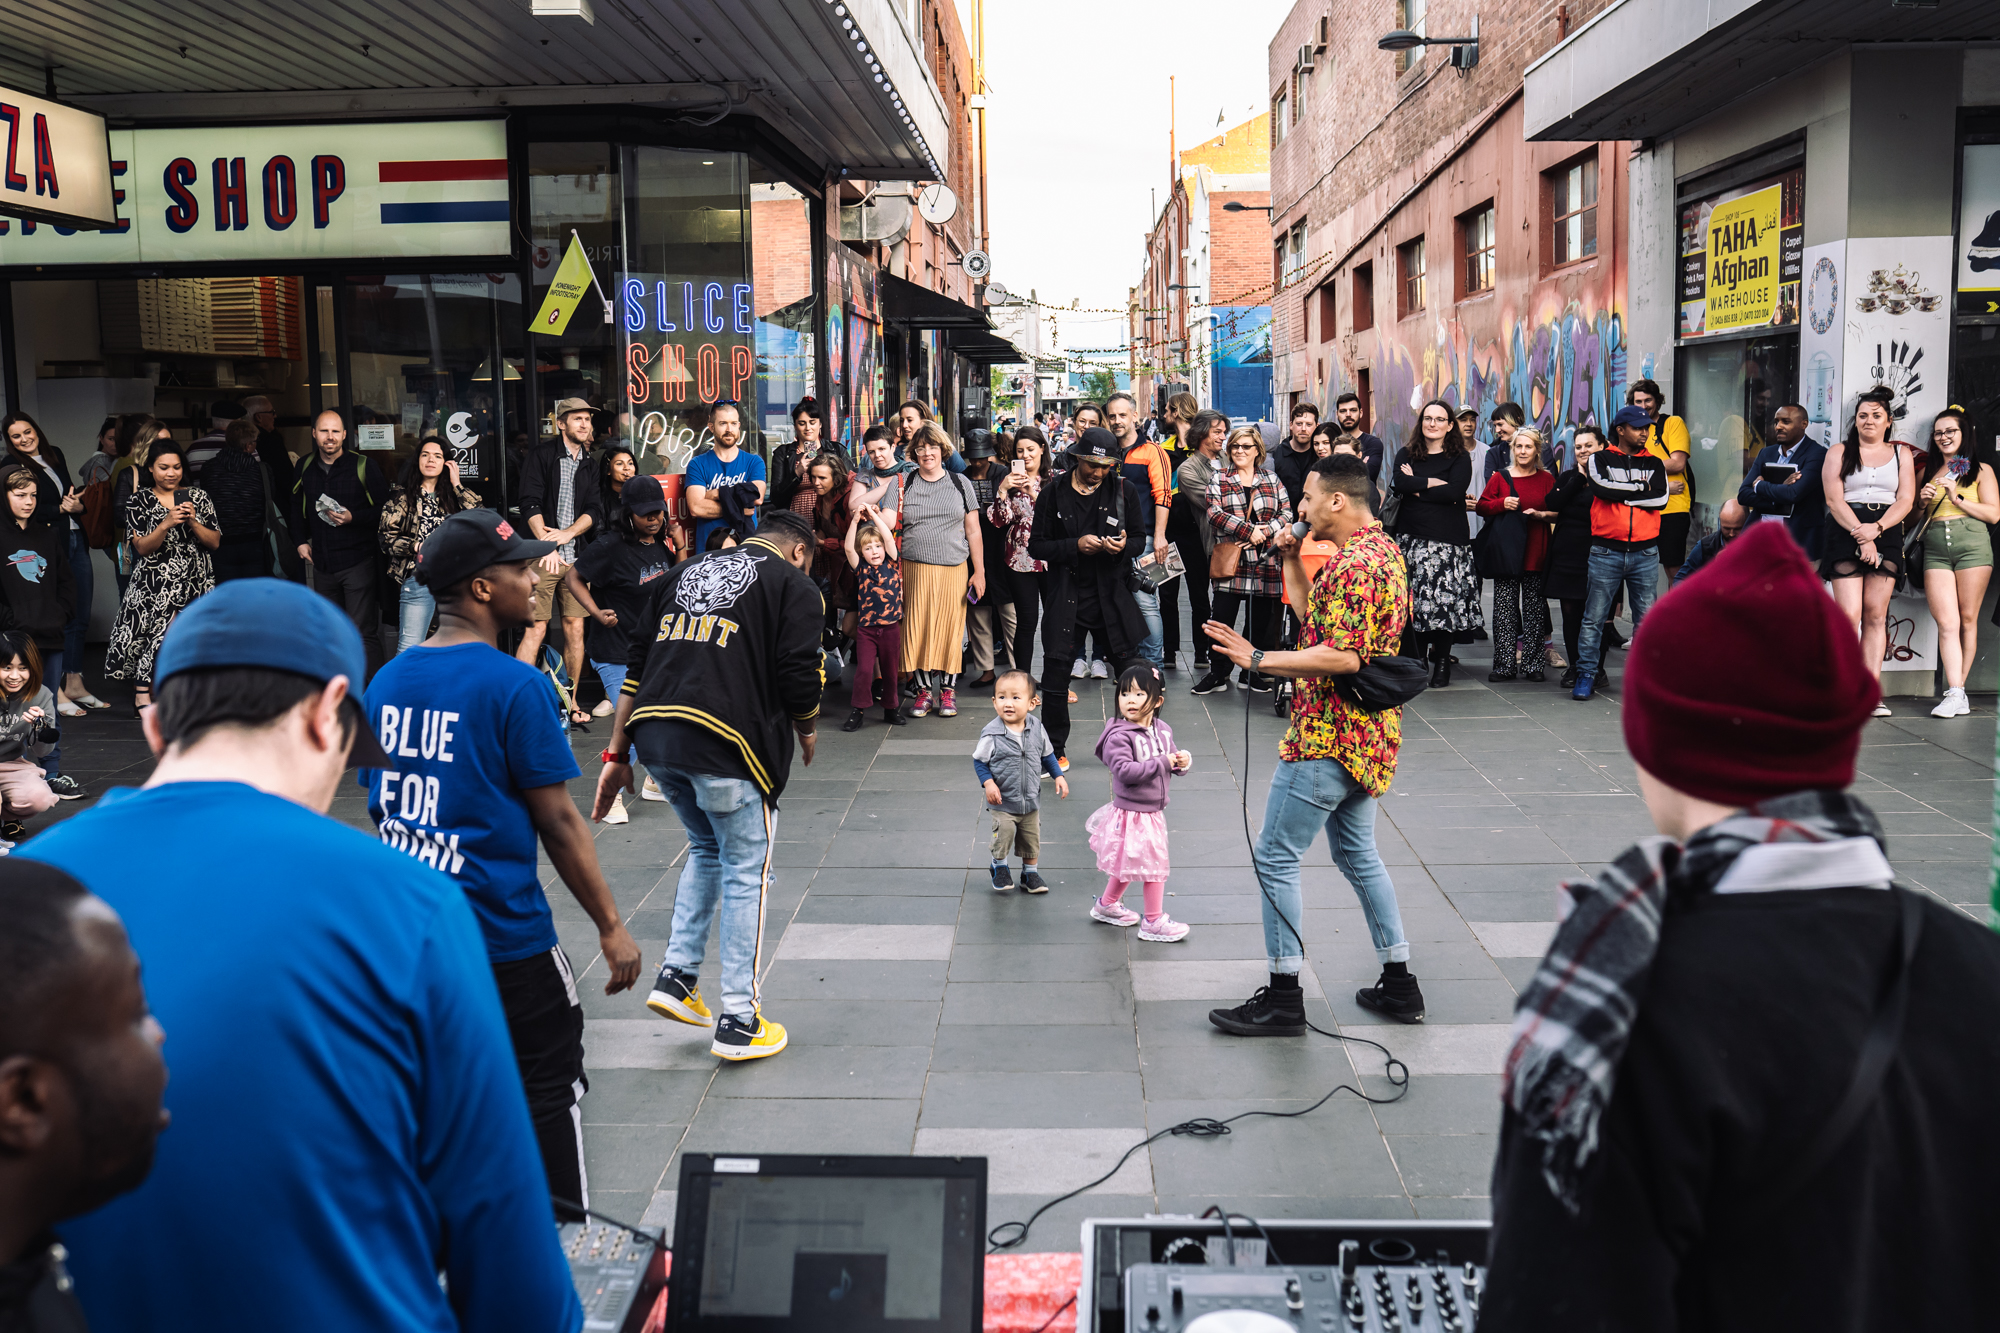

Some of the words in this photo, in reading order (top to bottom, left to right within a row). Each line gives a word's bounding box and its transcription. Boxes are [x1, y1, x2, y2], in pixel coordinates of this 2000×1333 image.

[163, 155, 346, 234] SHOP
[1712, 217, 1758, 257] TAHA
[1711, 255, 1769, 292] Afghan
[1711, 287, 1769, 311] WAREHOUSE
[624, 279, 752, 334] SLICE
[626, 342, 753, 404] SHOP
[656, 613, 739, 648] SAINT
[380, 705, 460, 762] BLUE
[379, 771, 440, 826] FOR
